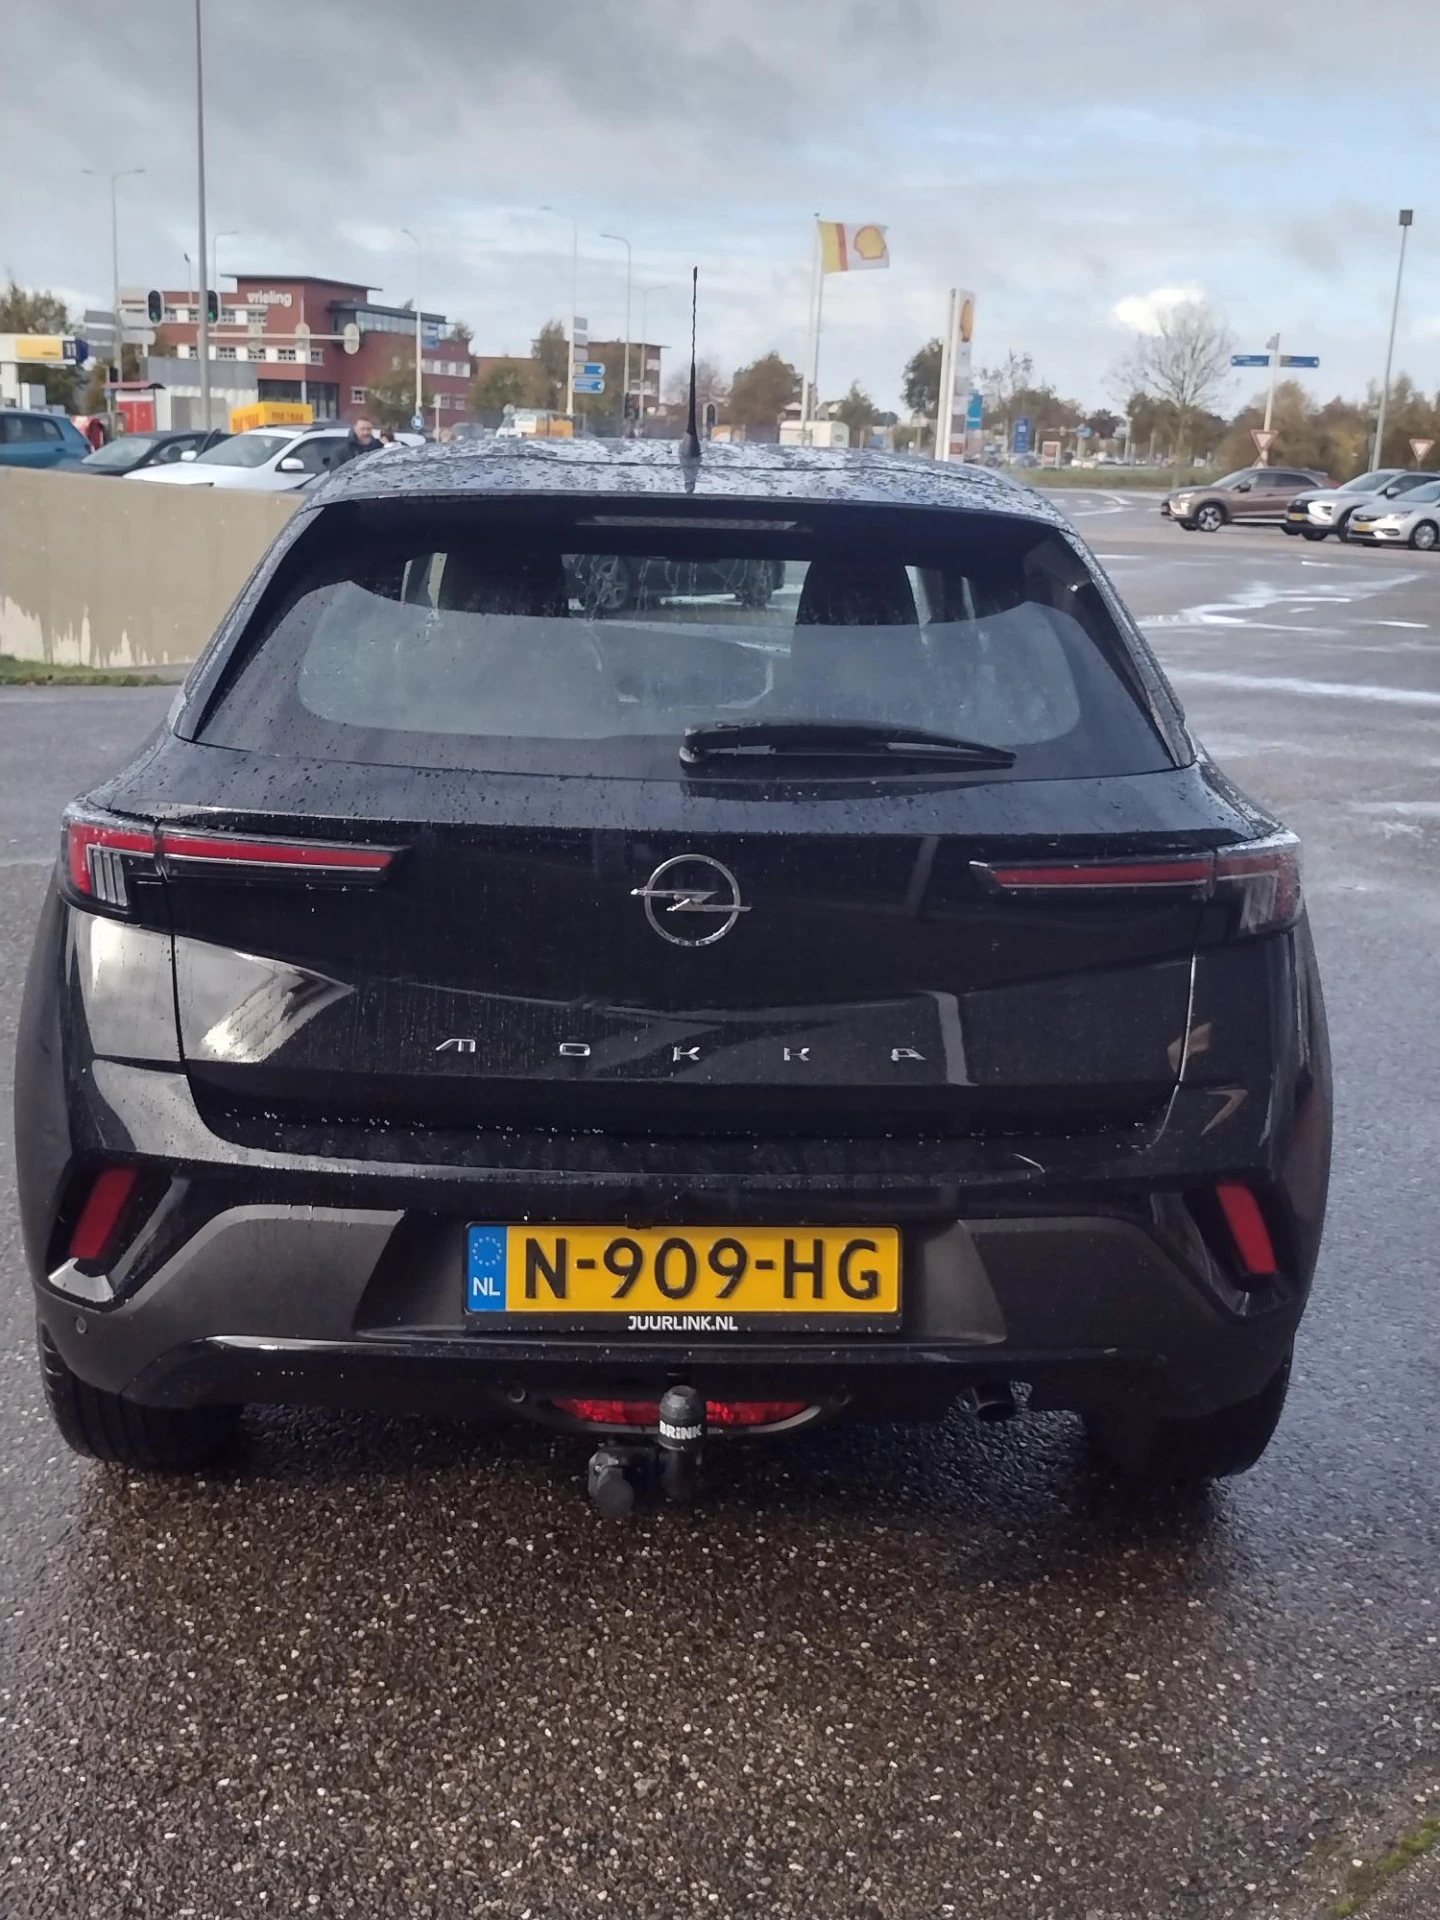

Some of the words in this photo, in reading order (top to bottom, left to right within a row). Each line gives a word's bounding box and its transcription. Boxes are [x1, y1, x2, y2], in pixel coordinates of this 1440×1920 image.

[436, 1037, 926, 1061] MOKKA
[524, 1237, 881, 1300] N-909-HG
[472, 1277, 501, 1297] NL
[627, 1315, 739, 1331] JUURLINK.NL
